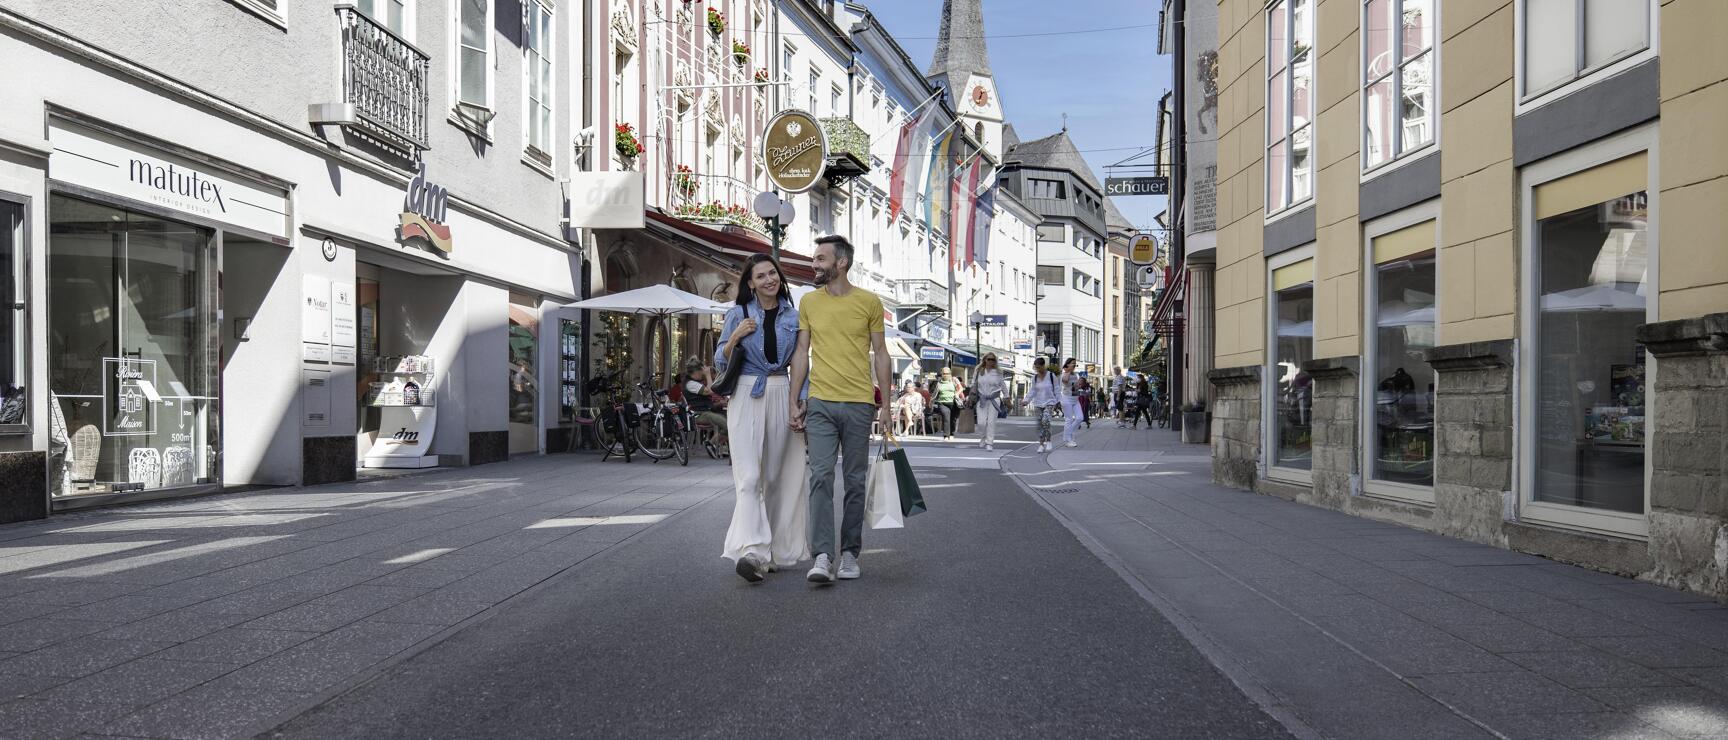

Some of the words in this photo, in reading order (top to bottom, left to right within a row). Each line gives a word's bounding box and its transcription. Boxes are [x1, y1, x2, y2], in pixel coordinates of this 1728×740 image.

[130, 158, 226, 213] matutex
[586, 179, 630, 205] dm
[1107, 181, 1166, 194] schauer
[408, 163, 449, 223] dm
[313, 297, 327, 308] Notar
[117, 416, 143, 428] Maison
[392, 428, 418, 440] dm
